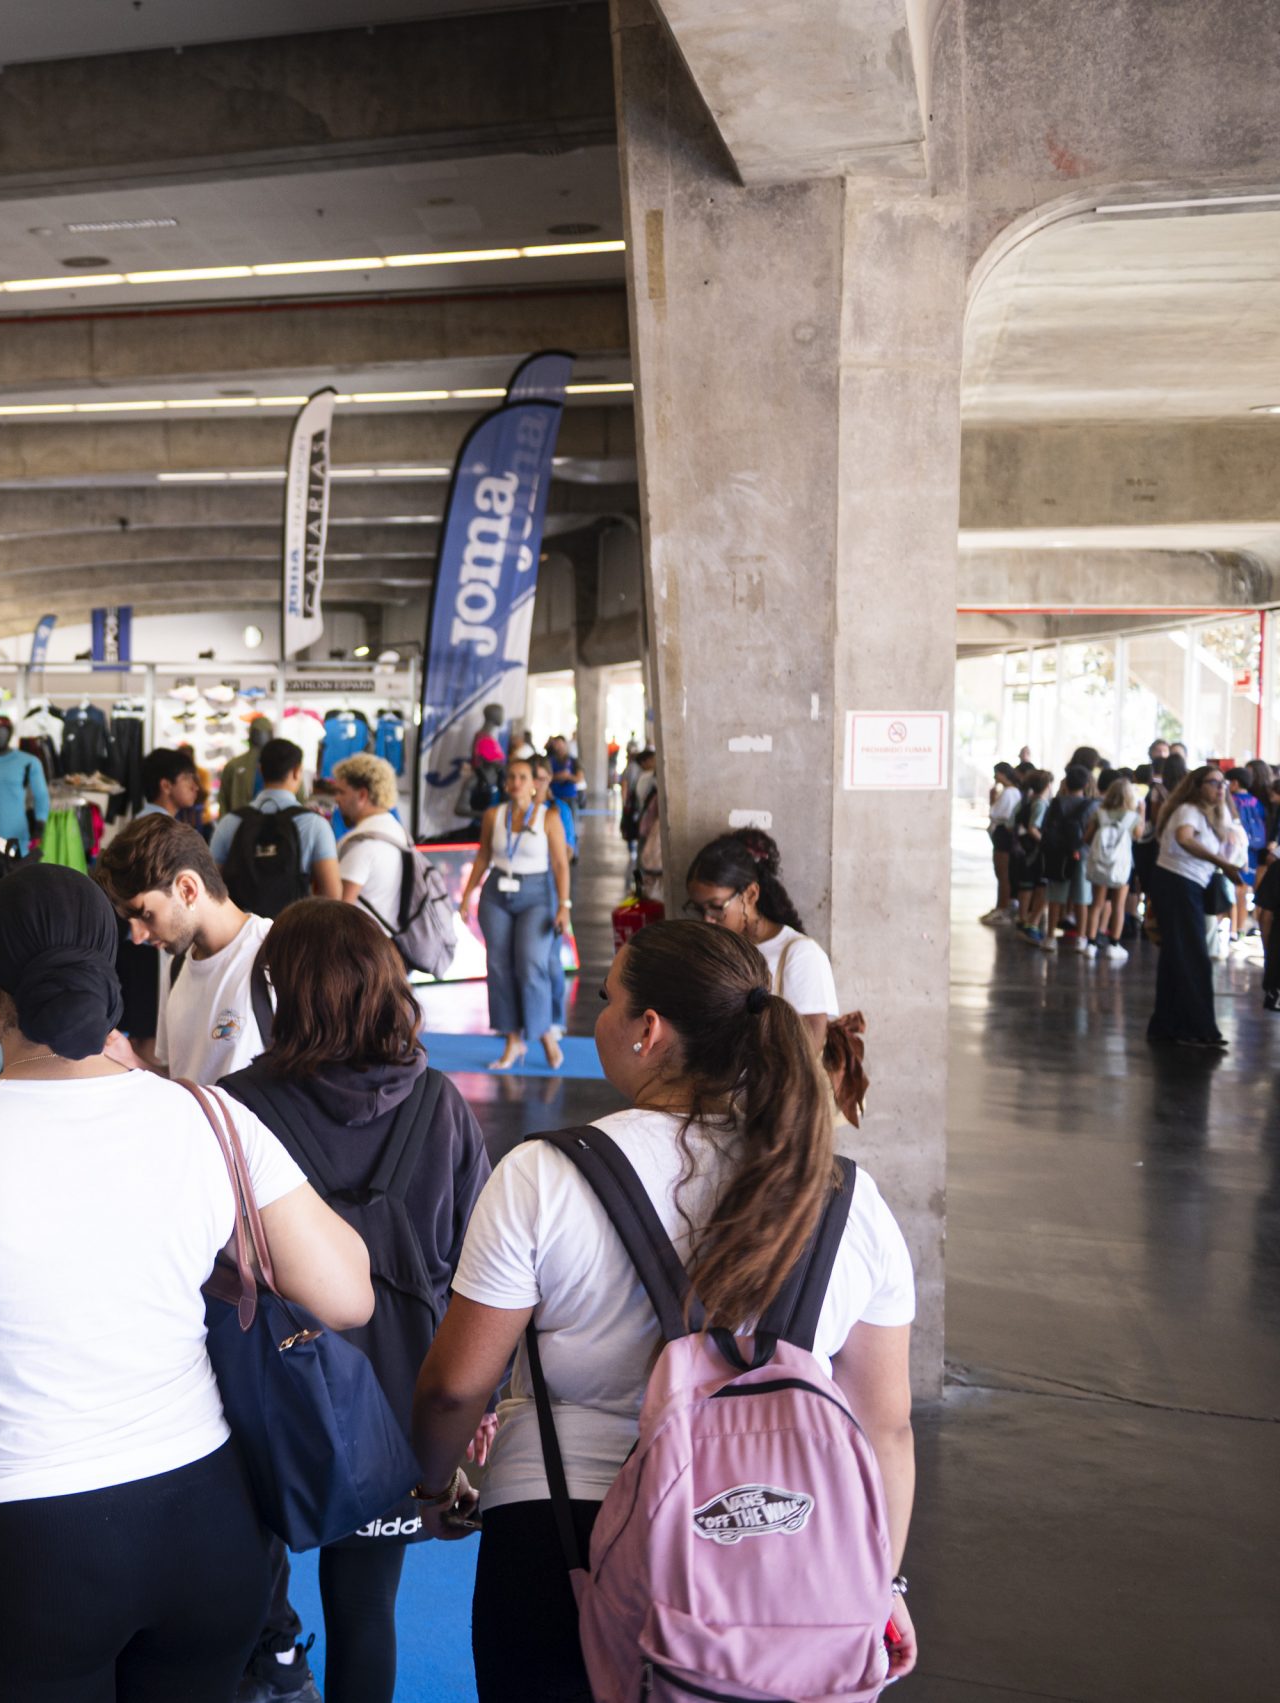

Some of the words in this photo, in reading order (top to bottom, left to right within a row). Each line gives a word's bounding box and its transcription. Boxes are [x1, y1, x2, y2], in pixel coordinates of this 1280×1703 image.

[449, 470, 520, 657] Joma
[721, 1490, 766, 1513] VANS
[730, 1506, 766, 1528] THE
